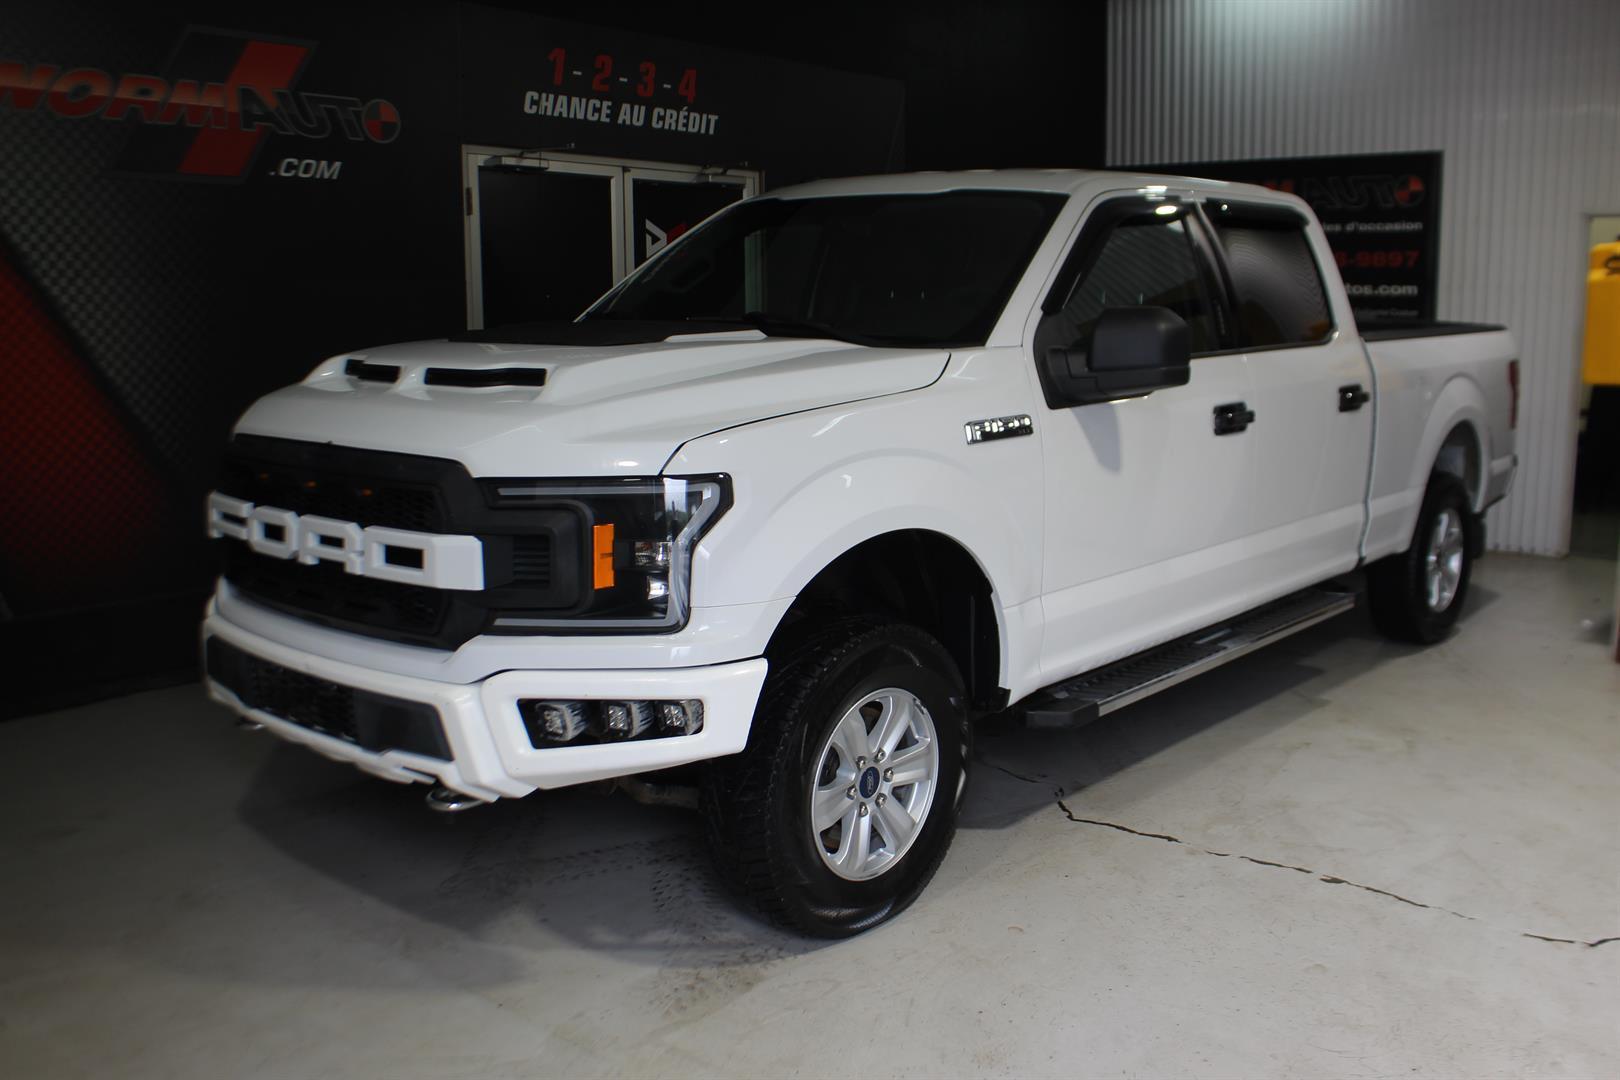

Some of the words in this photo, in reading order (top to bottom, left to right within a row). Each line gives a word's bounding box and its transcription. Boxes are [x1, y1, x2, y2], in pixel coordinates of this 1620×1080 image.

[523, 90, 613, 124] CHANCE
[617, 102, 647, 128] AU
[651, 106, 720, 136] CRÉDIT
[268, 157, 342, 181] .COM
[1346, 281, 1419, 296] tos.com
[206, 488, 485, 592] FORD
